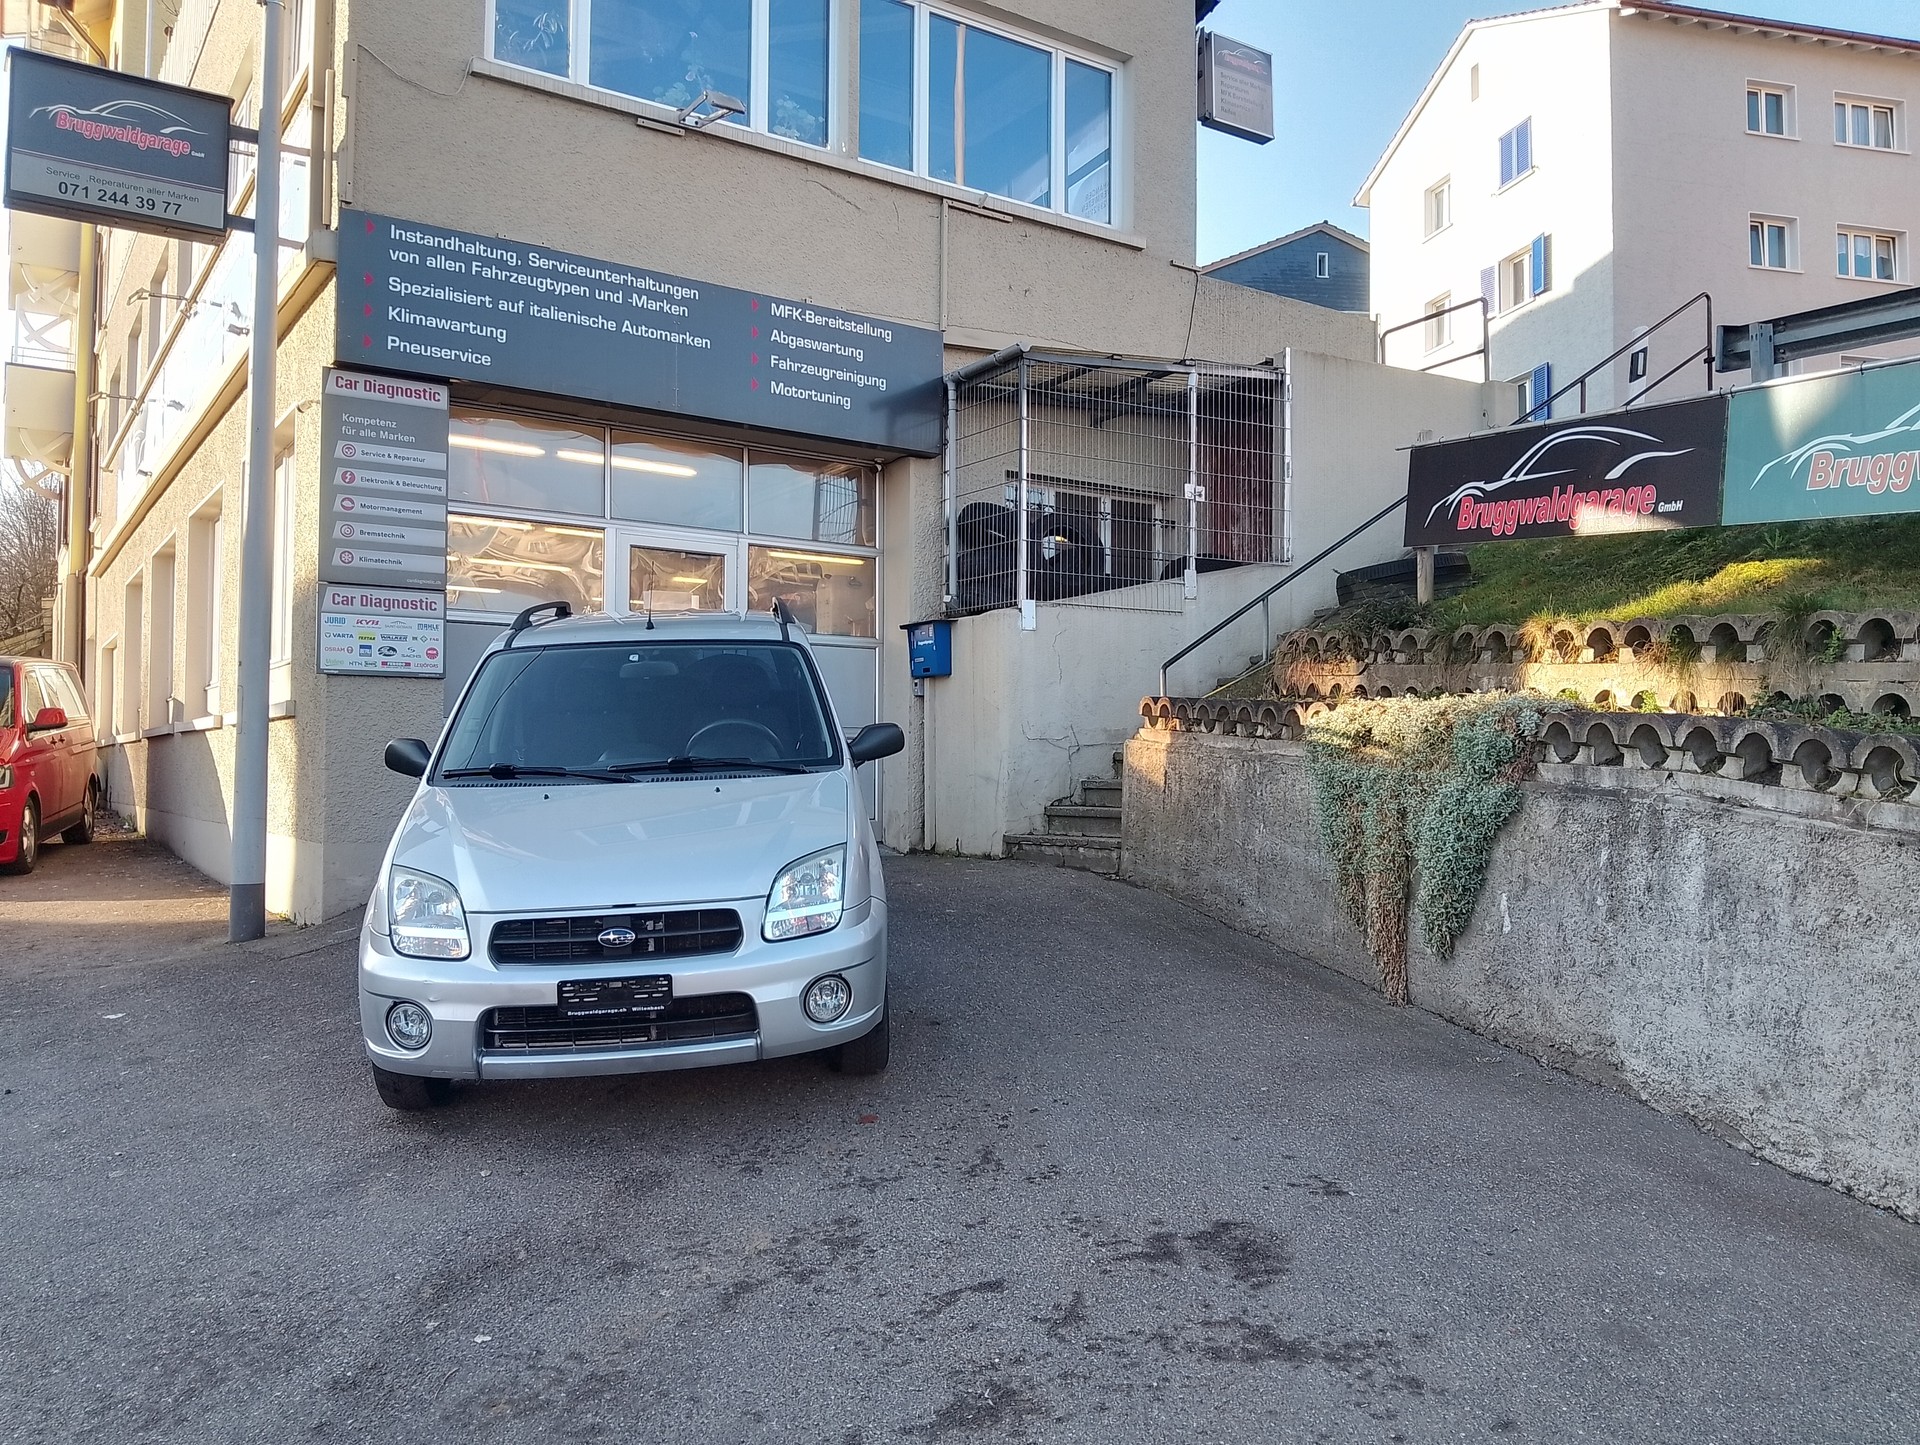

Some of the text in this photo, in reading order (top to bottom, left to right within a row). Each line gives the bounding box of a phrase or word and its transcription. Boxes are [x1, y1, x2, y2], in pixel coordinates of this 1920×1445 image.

[56, 111, 191, 158] Bruggwaldgarage
[46, 166, 80, 181] Service
[147, 185, 166, 197] aller
[167, 189, 200, 204] Marken
[58, 181, 182, 216] 071 244 39 77
[390, 224, 699, 300] Instandhaltung, Serviceunterhaltungen
[389, 248, 689, 317] von allen Fahrzeugtypen und -Marken
[387, 305, 507, 344] Klimawartung
[388, 276, 712, 350] Spezialisiert auf italienische Automarken
[771, 302, 893, 343] MFK-Bereitstellung
[387, 335, 492, 366] Pneuservice
[770, 329, 864, 362] Abgaswartung
[335, 375, 441, 402] Car Diagnostic
[770, 355, 887, 391] Fahrzeugreinigung
[770, 380, 851, 410] Motortuning
[341, 425, 416, 443] für alle Marken
[342, 412, 397, 428] Kompetenz
[360, 449, 426, 463] Service & Reparatur
[360, 475, 394, 486] Elektronik
[402, 480, 443, 492] Beleuchtung
[1806, 450, 1920, 495] Brugg
[360, 502, 423, 515] Motormanagement
[1456, 484, 1684, 536] Bruggwaldgarage GmbH
[359, 529, 406, 539] Bremstechnik
[359, 556, 403, 566] Klimatechnik
[332, 592, 437, 612] Car Diagnostic
[324, 616, 346, 625] JURID
[567, 1007, 627, 1016] Bruggwaldgarage.ch
